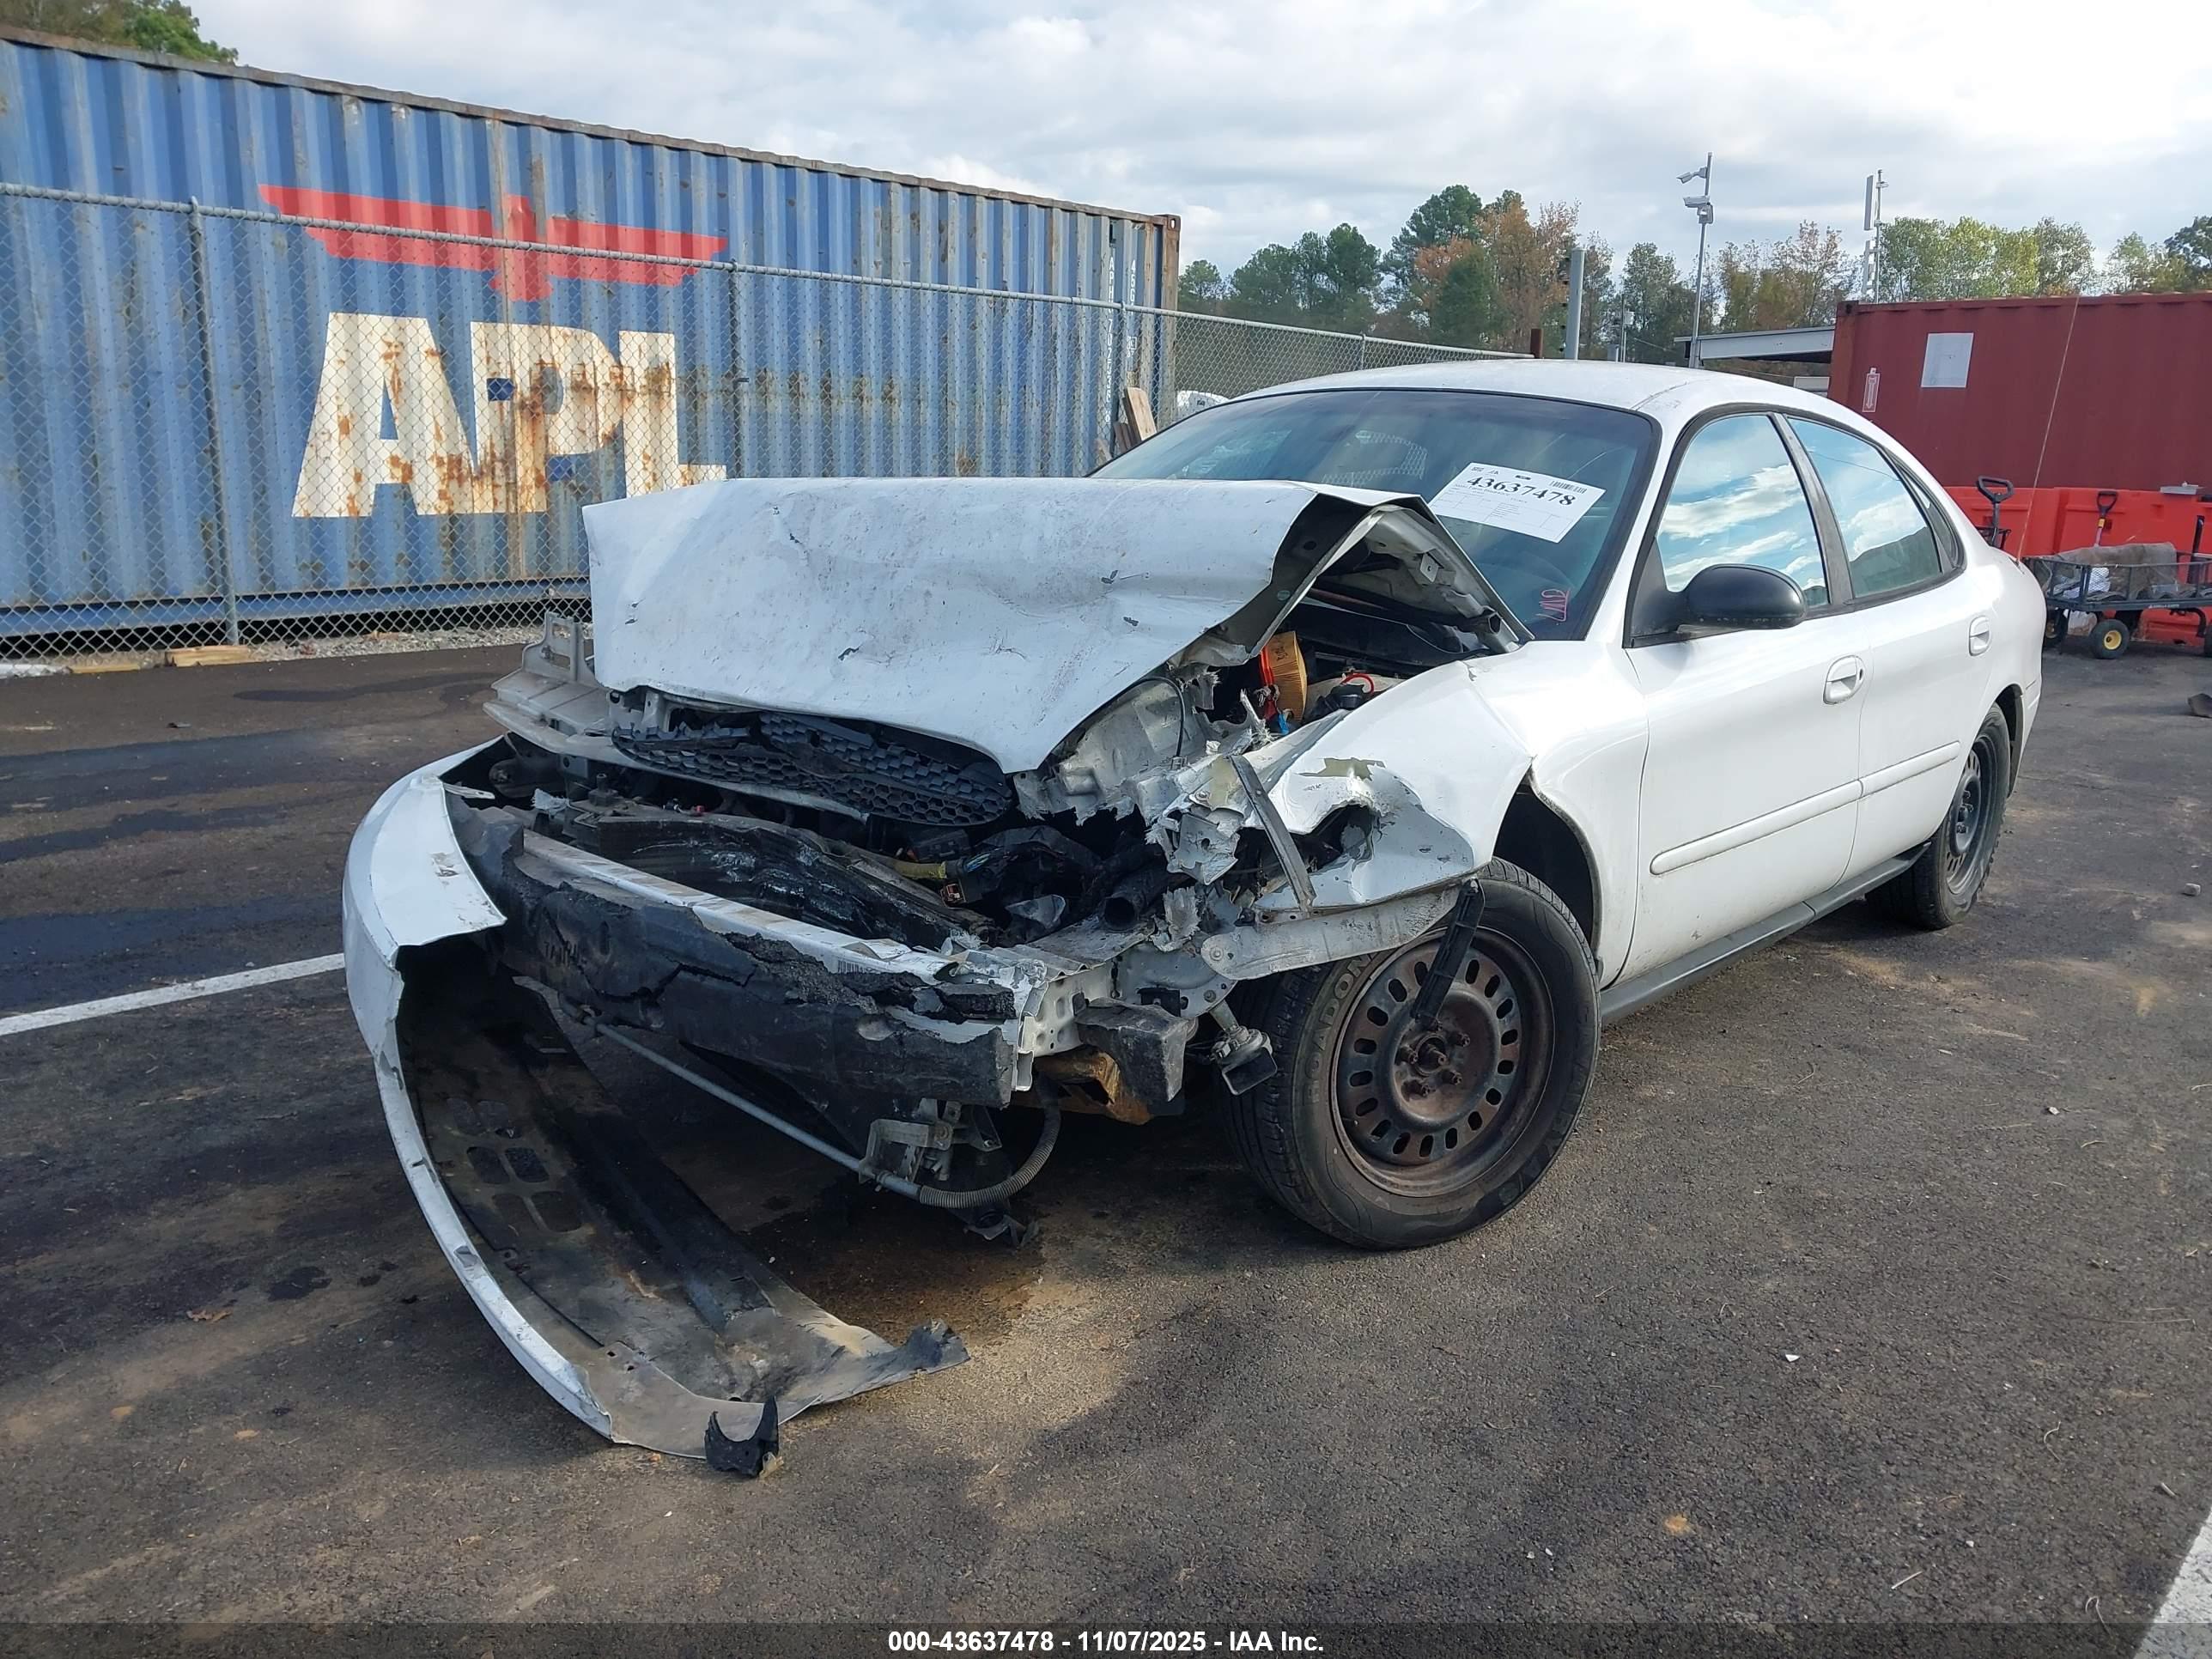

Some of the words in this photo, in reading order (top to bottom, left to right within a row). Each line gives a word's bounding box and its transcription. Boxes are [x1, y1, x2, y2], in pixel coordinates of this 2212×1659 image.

[291, 312, 727, 518] APL
[1467, 476, 1577, 507] 43637478
[1303, 952, 1379, 1105] ROADON
